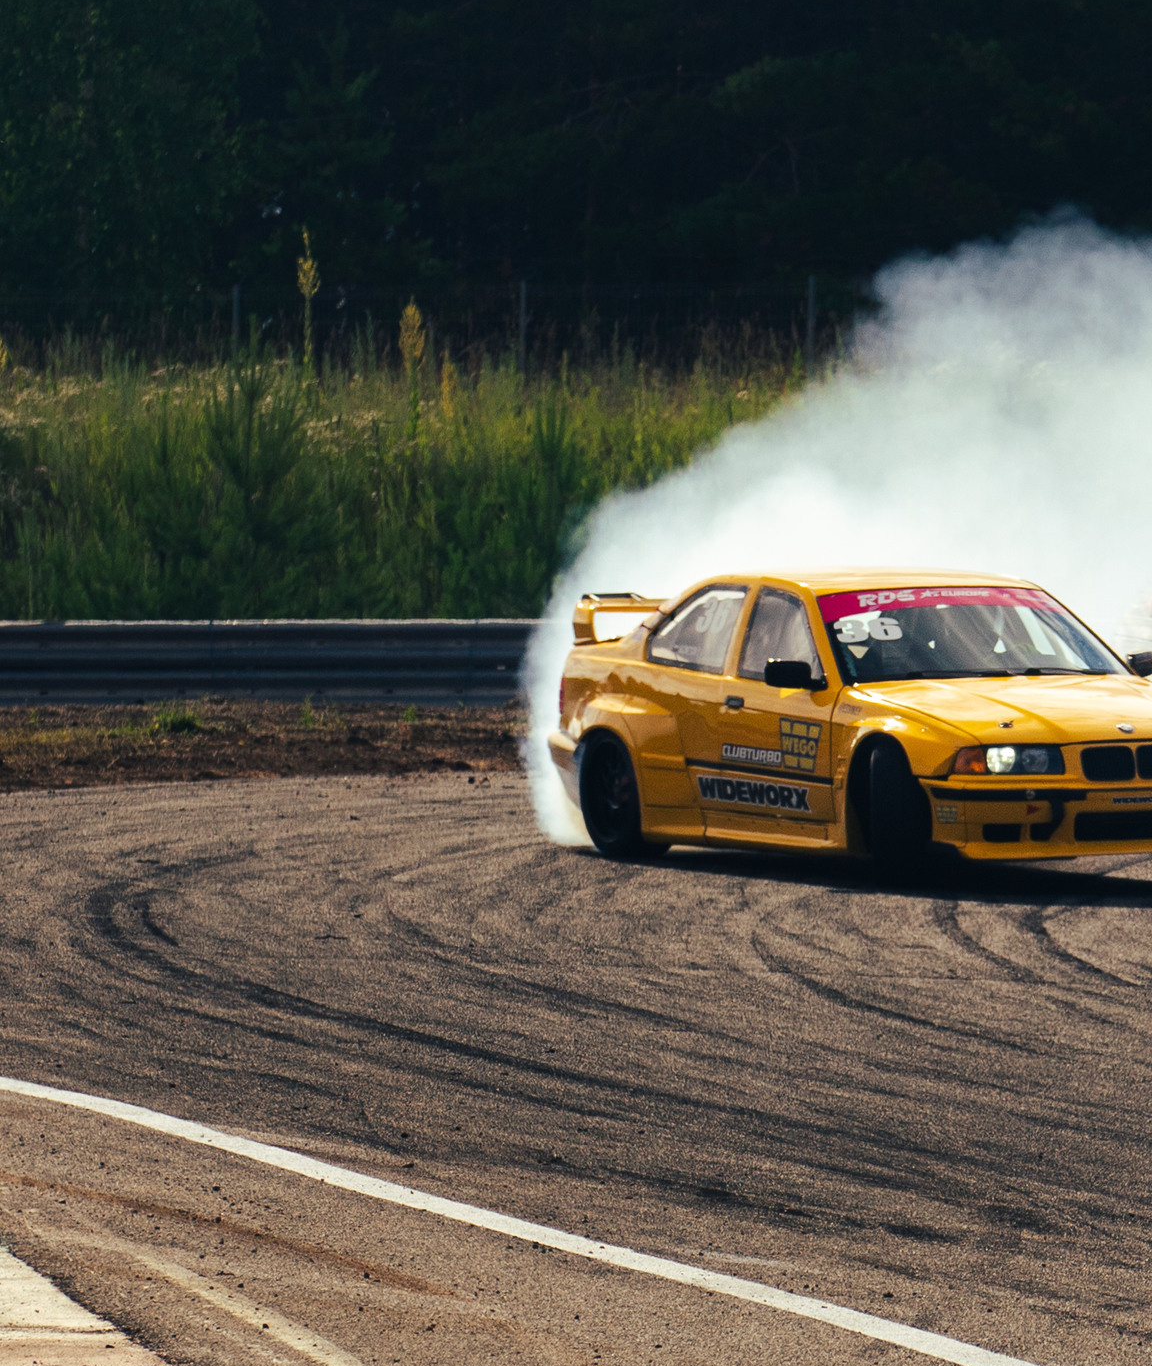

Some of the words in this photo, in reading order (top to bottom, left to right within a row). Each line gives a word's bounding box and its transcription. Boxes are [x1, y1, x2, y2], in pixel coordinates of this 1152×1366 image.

[857, 589, 915, 608] RDS
[695, 596, 733, 634] 36
[833, 617, 903, 643] 36
[722, 744, 782, 764] CLUBTURBO
[782, 736, 817, 758] WEGO
[699, 776, 810, 812] WIDEWORX
